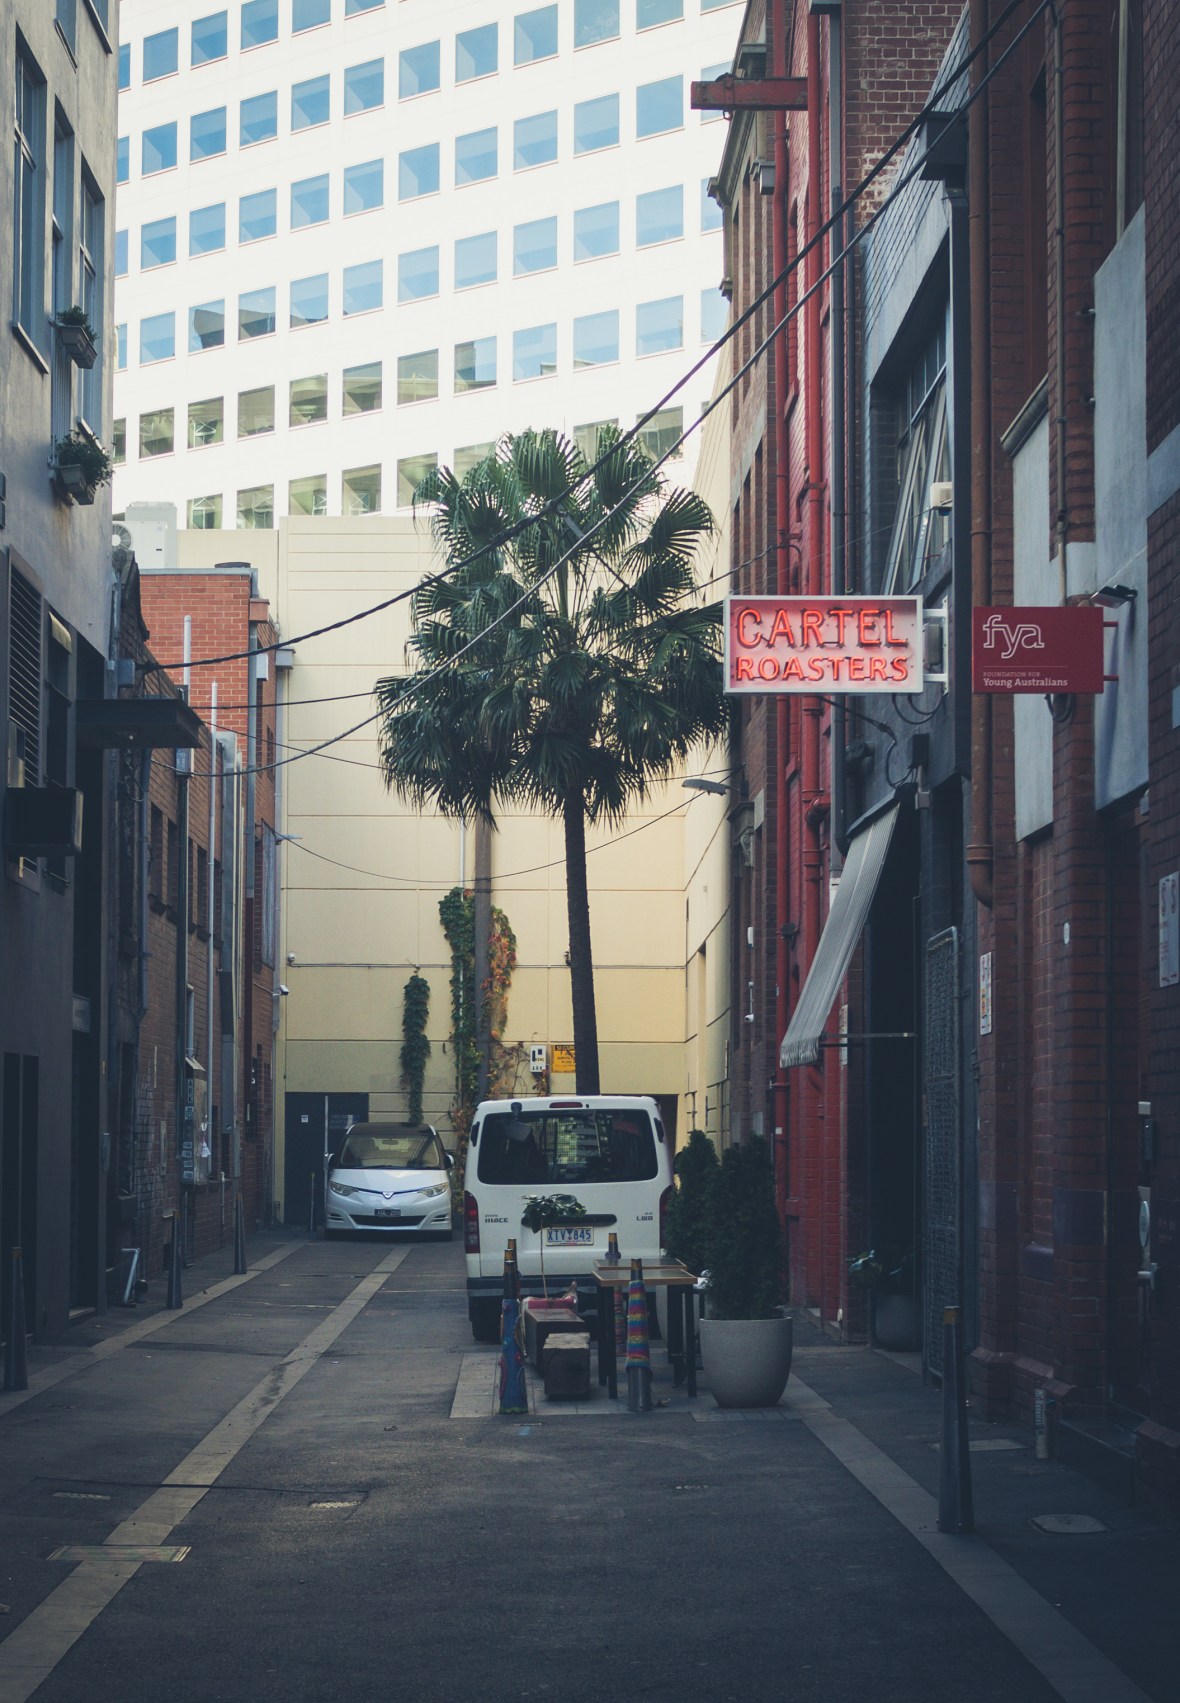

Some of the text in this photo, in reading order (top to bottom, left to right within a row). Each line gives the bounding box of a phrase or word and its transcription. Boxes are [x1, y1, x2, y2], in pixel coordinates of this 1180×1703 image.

[737, 608, 908, 647] CARTEL
[982, 614, 1045, 659] fya
[736, 655, 908, 681] ROASTERS
[983, 678, 1068, 688] Young Australians
[547, 1229, 591, 1241] XTV 845
